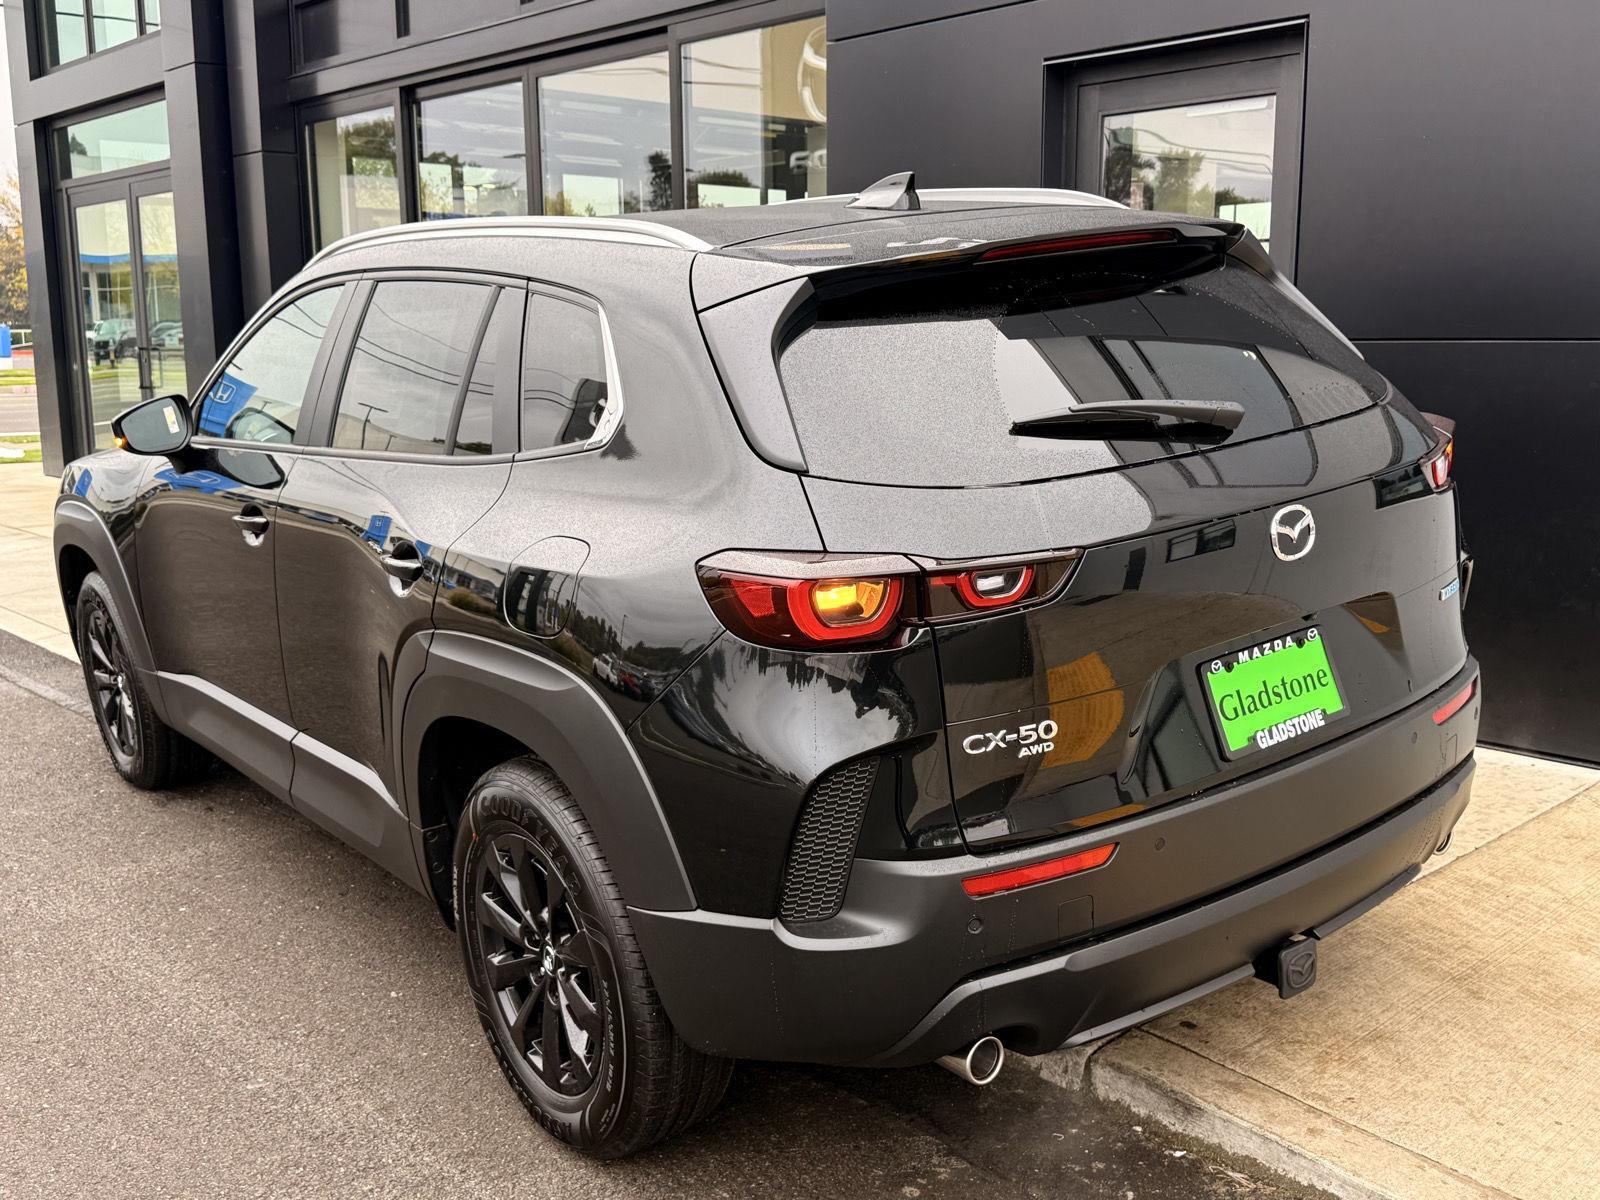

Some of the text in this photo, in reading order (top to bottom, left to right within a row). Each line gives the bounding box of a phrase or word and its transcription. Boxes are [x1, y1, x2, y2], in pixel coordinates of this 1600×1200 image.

[1238, 636, 1294, 664] MAZDA
[1219, 668, 1329, 721] Gladstone
[962, 720, 1058, 755] CX-50
[1256, 709, 1326, 749] GLADSTONE
[1018, 741, 1055, 758] AWD
